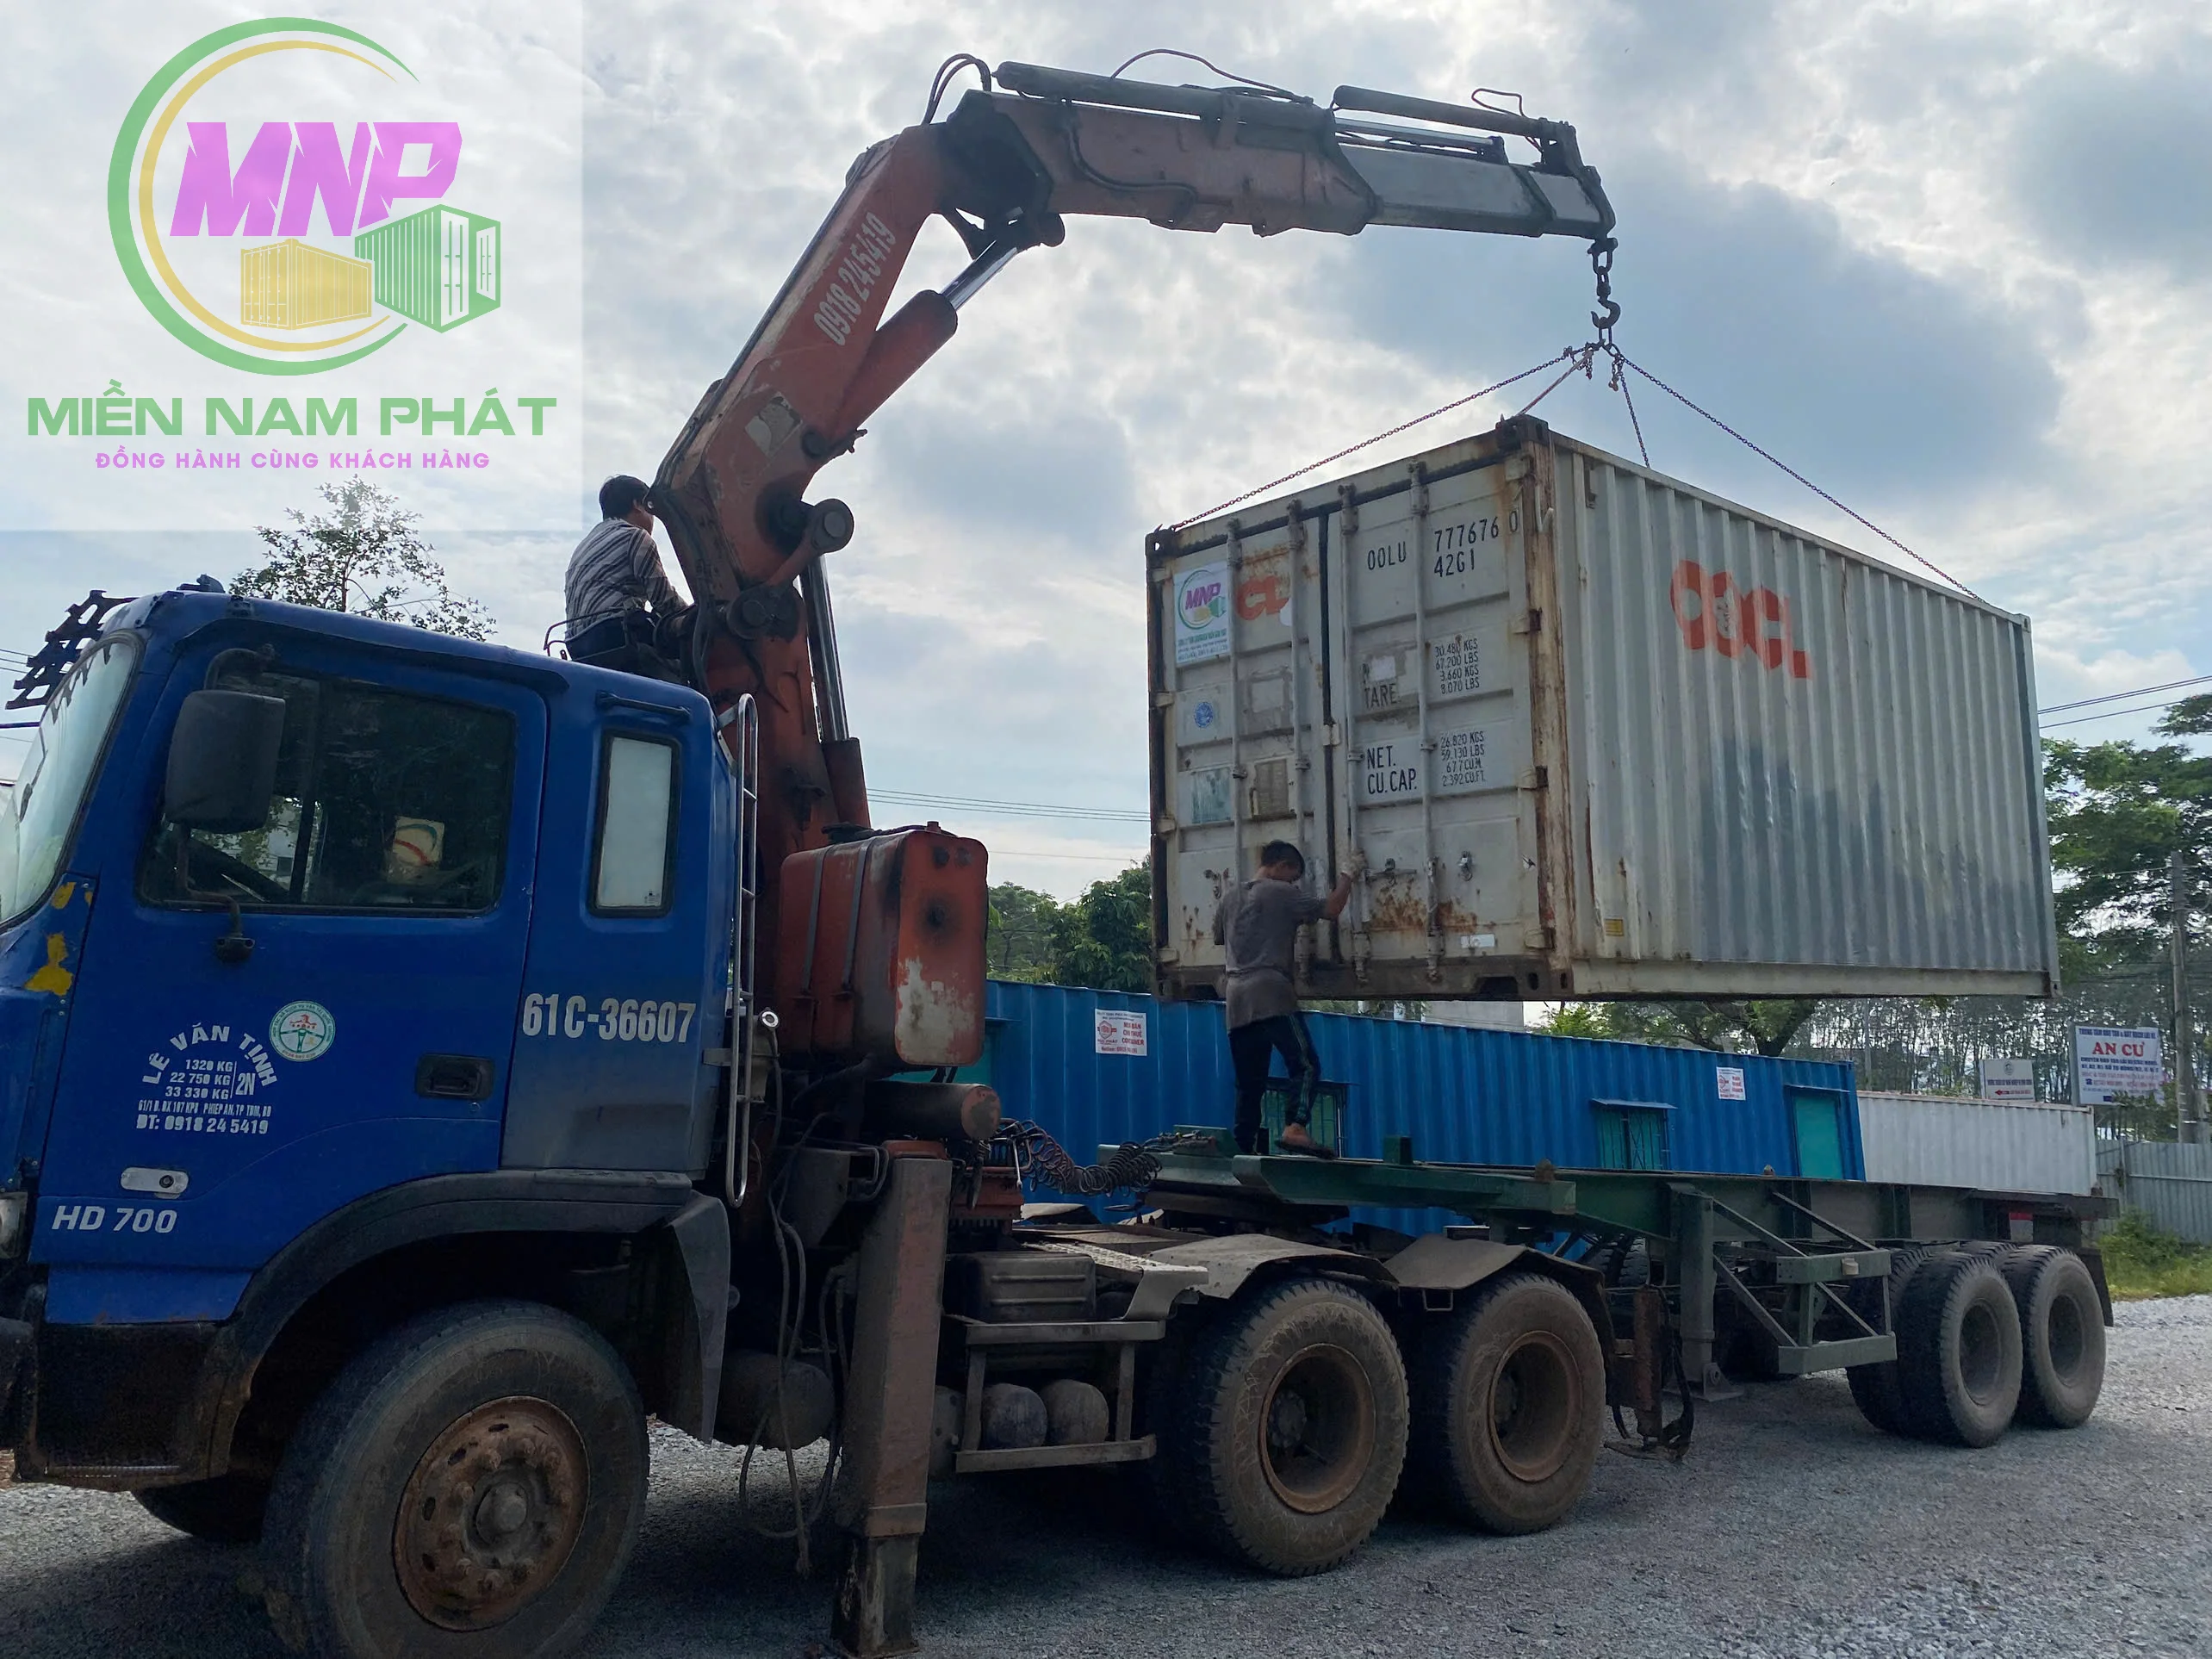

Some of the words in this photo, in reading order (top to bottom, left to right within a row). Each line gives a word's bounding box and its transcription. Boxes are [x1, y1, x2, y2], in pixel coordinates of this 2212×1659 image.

[814, 283, 861, 346] 0918
[1434, 516, 1500, 552] 777676
[1433, 548, 1475, 578] 42G1
[1184, 581, 1221, 610] MNP
[1463, 637, 1479, 652] KGS
[1463, 651, 1479, 665] LBS
[1464, 664, 1480, 678] KGS
[1464, 677, 1480, 691] LBS
[1469, 730, 1485, 744] KGS
[1367, 745, 1396, 769] NET.
[1469, 743, 1485, 757] LBS
[2092, 1041, 2117, 1055] AN
[2122, 1041, 2146, 1057] CƯ
[185, 1059, 214, 1071] 1320
[216, 1060, 233, 1072] KG
[239, 1033, 277, 1087] TỊNH
[170, 1072, 185, 1083] 22
[189, 1072, 210, 1084] 750
[214, 1074, 231, 1085] KG
[235, 1072, 256, 1096] 2N
[165, 1085, 181, 1097] 33
[184, 1086, 208, 1099] 330
[212, 1088, 229, 1100] KG
[165, 1115, 204, 1132] 0918
[206, 1117, 227, 1133] 24
[229, 1119, 269, 1134] 5419
[52, 1205, 106, 1230] HD
[113, 1208, 177, 1233] 700
